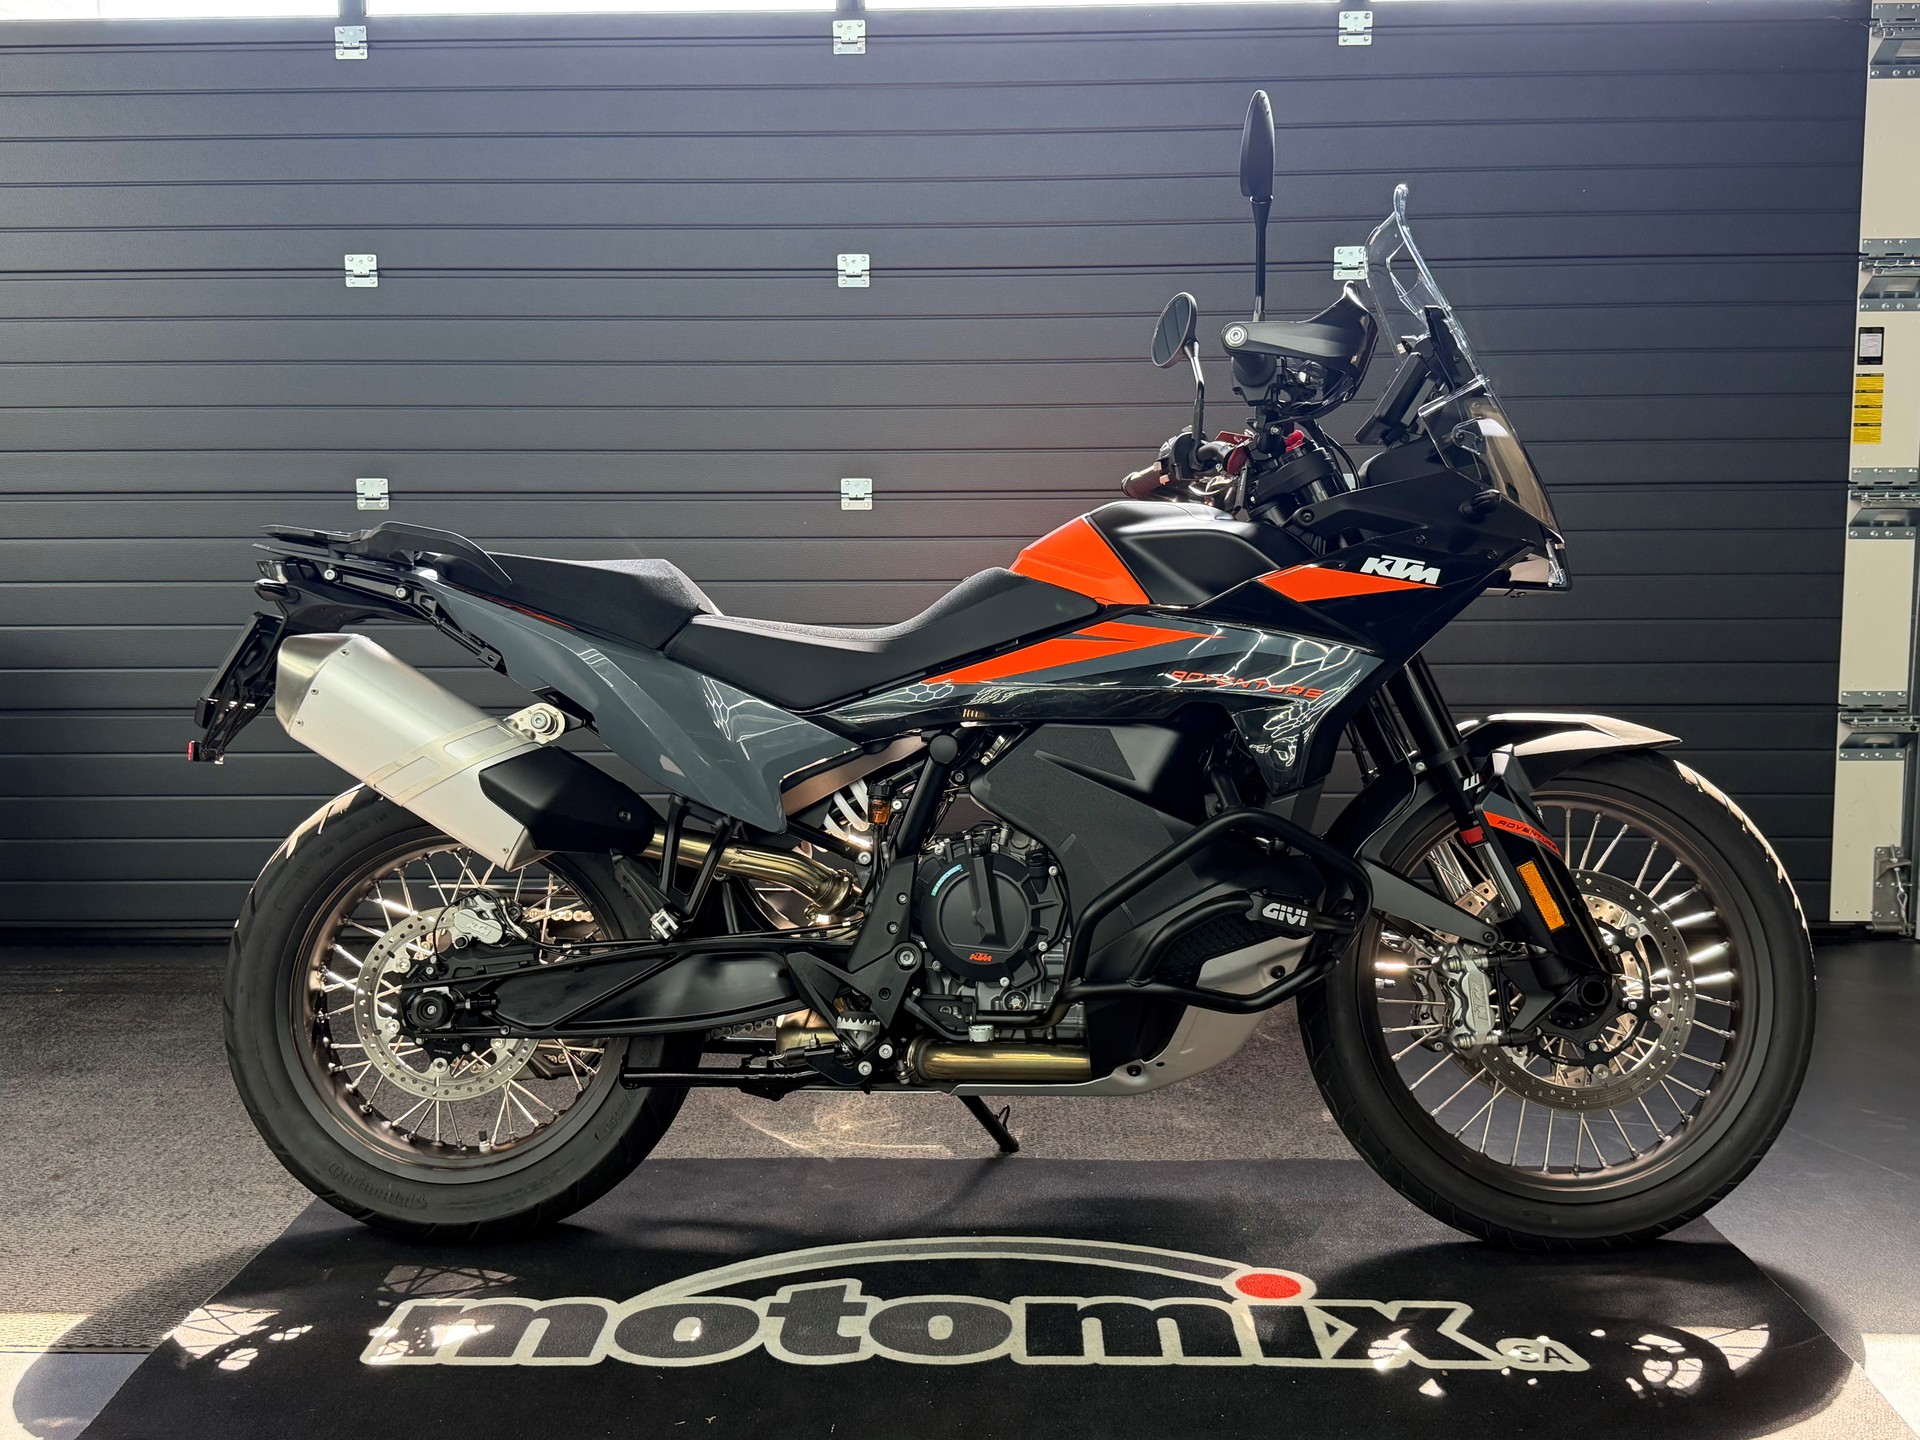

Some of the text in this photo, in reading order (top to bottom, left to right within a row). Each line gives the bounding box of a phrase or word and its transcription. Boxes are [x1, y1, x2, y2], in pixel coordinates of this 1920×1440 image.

[1360, 554, 1441, 585] KTM
[1170, 671, 1324, 699] ADVENTURE
[1497, 820, 1558, 850] ADVENTURE
[969, 952, 992, 962] KTM
[360, 1268, 1503, 1371] motomix
